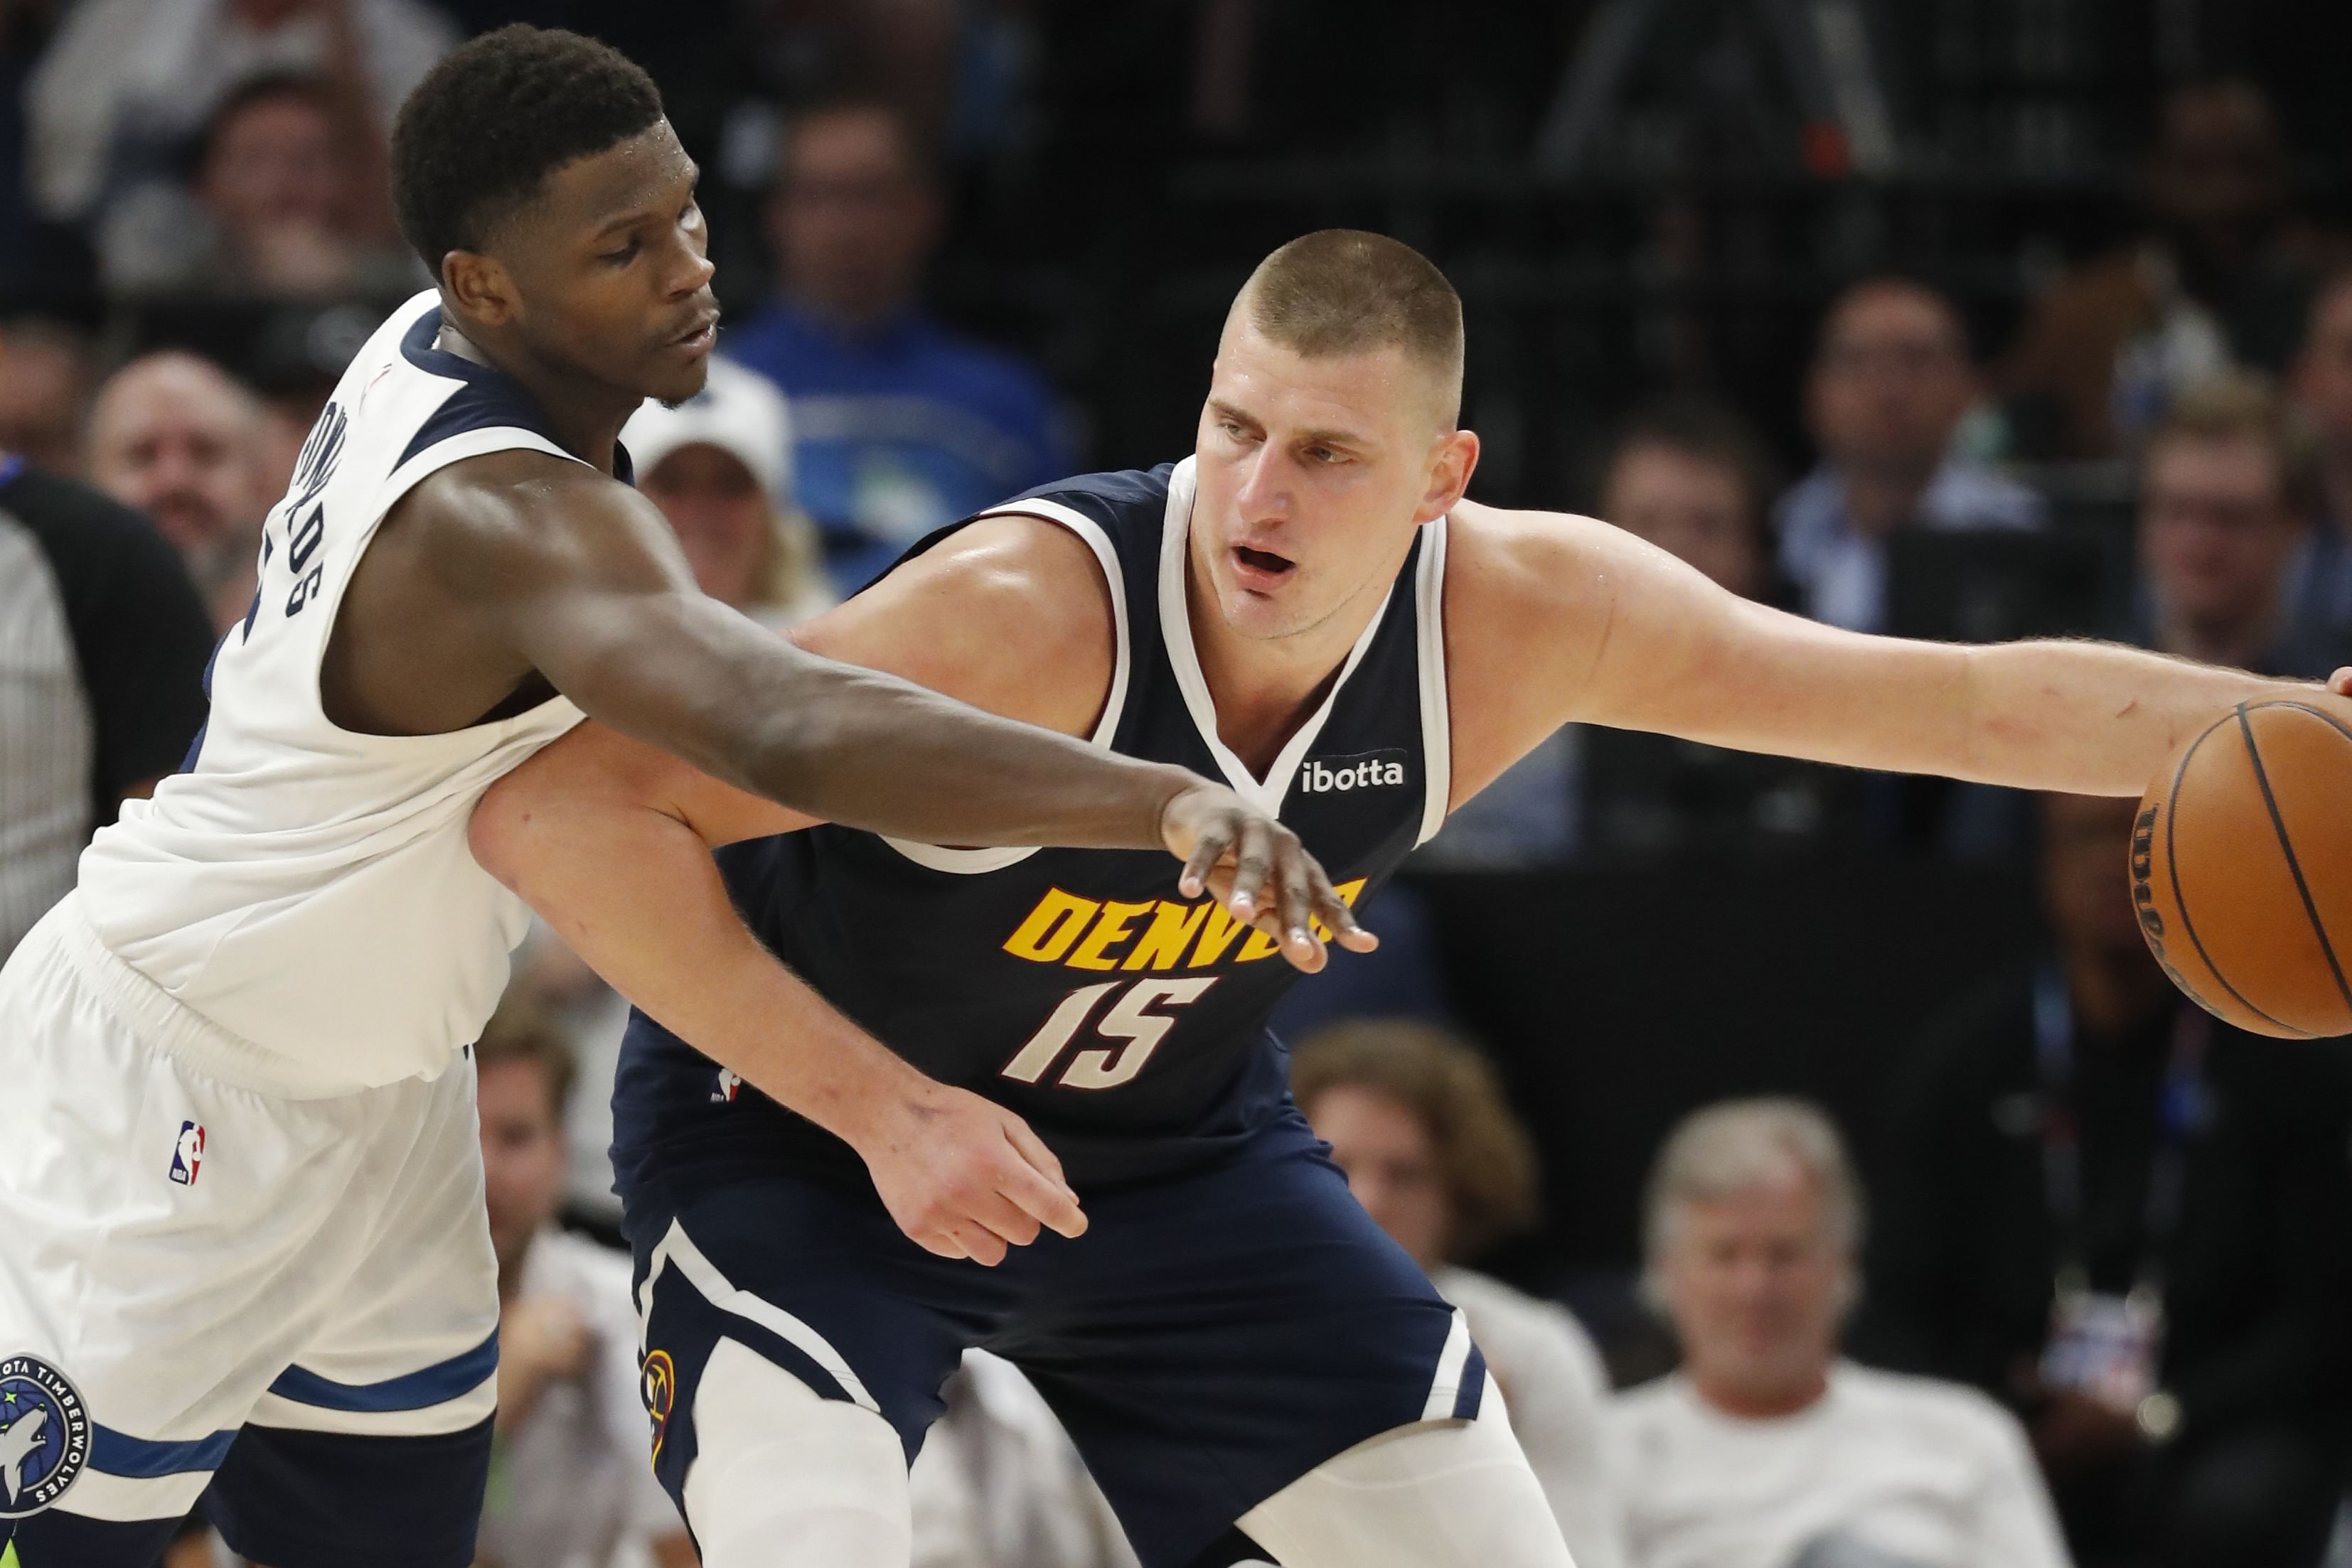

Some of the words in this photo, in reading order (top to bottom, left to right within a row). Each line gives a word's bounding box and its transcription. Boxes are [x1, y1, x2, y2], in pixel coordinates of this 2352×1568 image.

[1302, 759, 1404, 793] ibotta
[1000, 975, 1222, 1090] 15
[0, 1360, 29, 1376] OTA
[36, 1367, 84, 1502] TIMBERWOLVES
